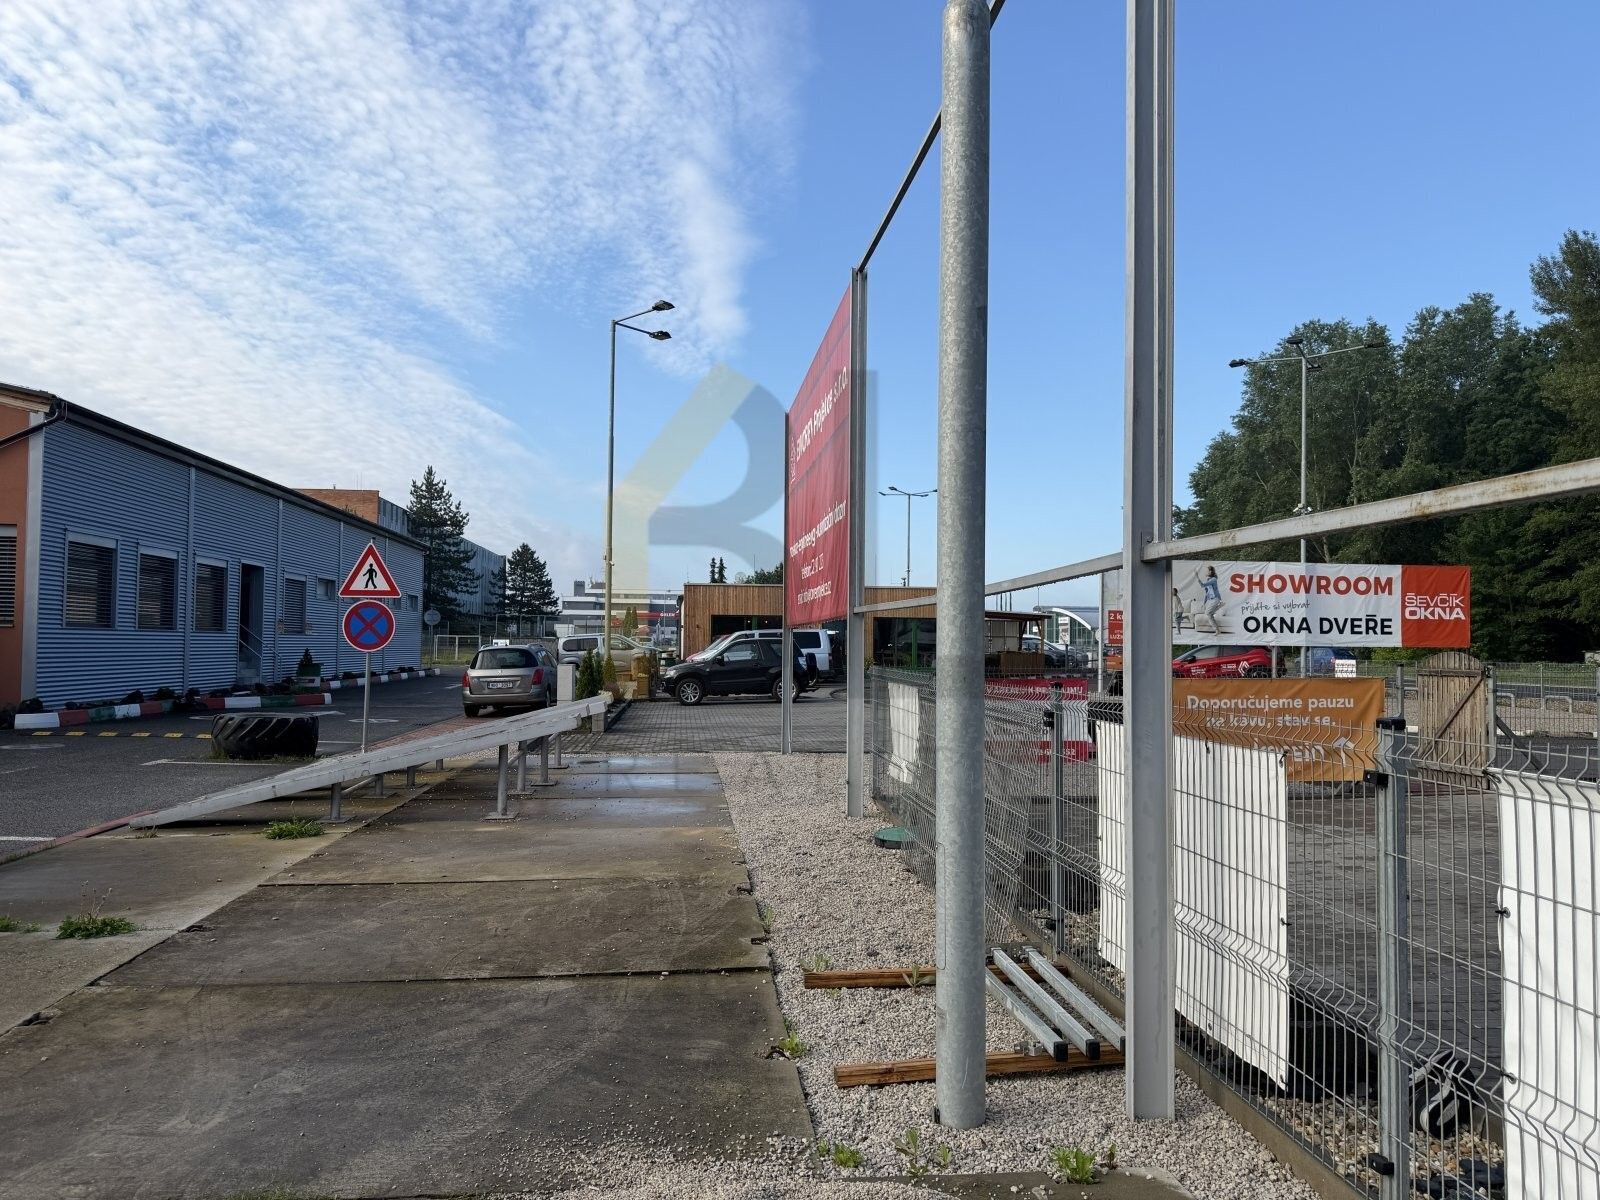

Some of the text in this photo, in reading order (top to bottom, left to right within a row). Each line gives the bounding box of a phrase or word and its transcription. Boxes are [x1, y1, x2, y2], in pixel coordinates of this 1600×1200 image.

[1229, 573, 1393, 596] SHOWROOM
[1273, 602, 1281, 611] si
[1283, 599, 1311, 613] vybrat
[1405, 607, 1466, 620] OKNA
[1243, 614, 1393, 635] OKNA DVEŘE
[1187, 695, 1354, 712] Doporučujeme pauzu
[1277, 715, 1309, 726] stav
